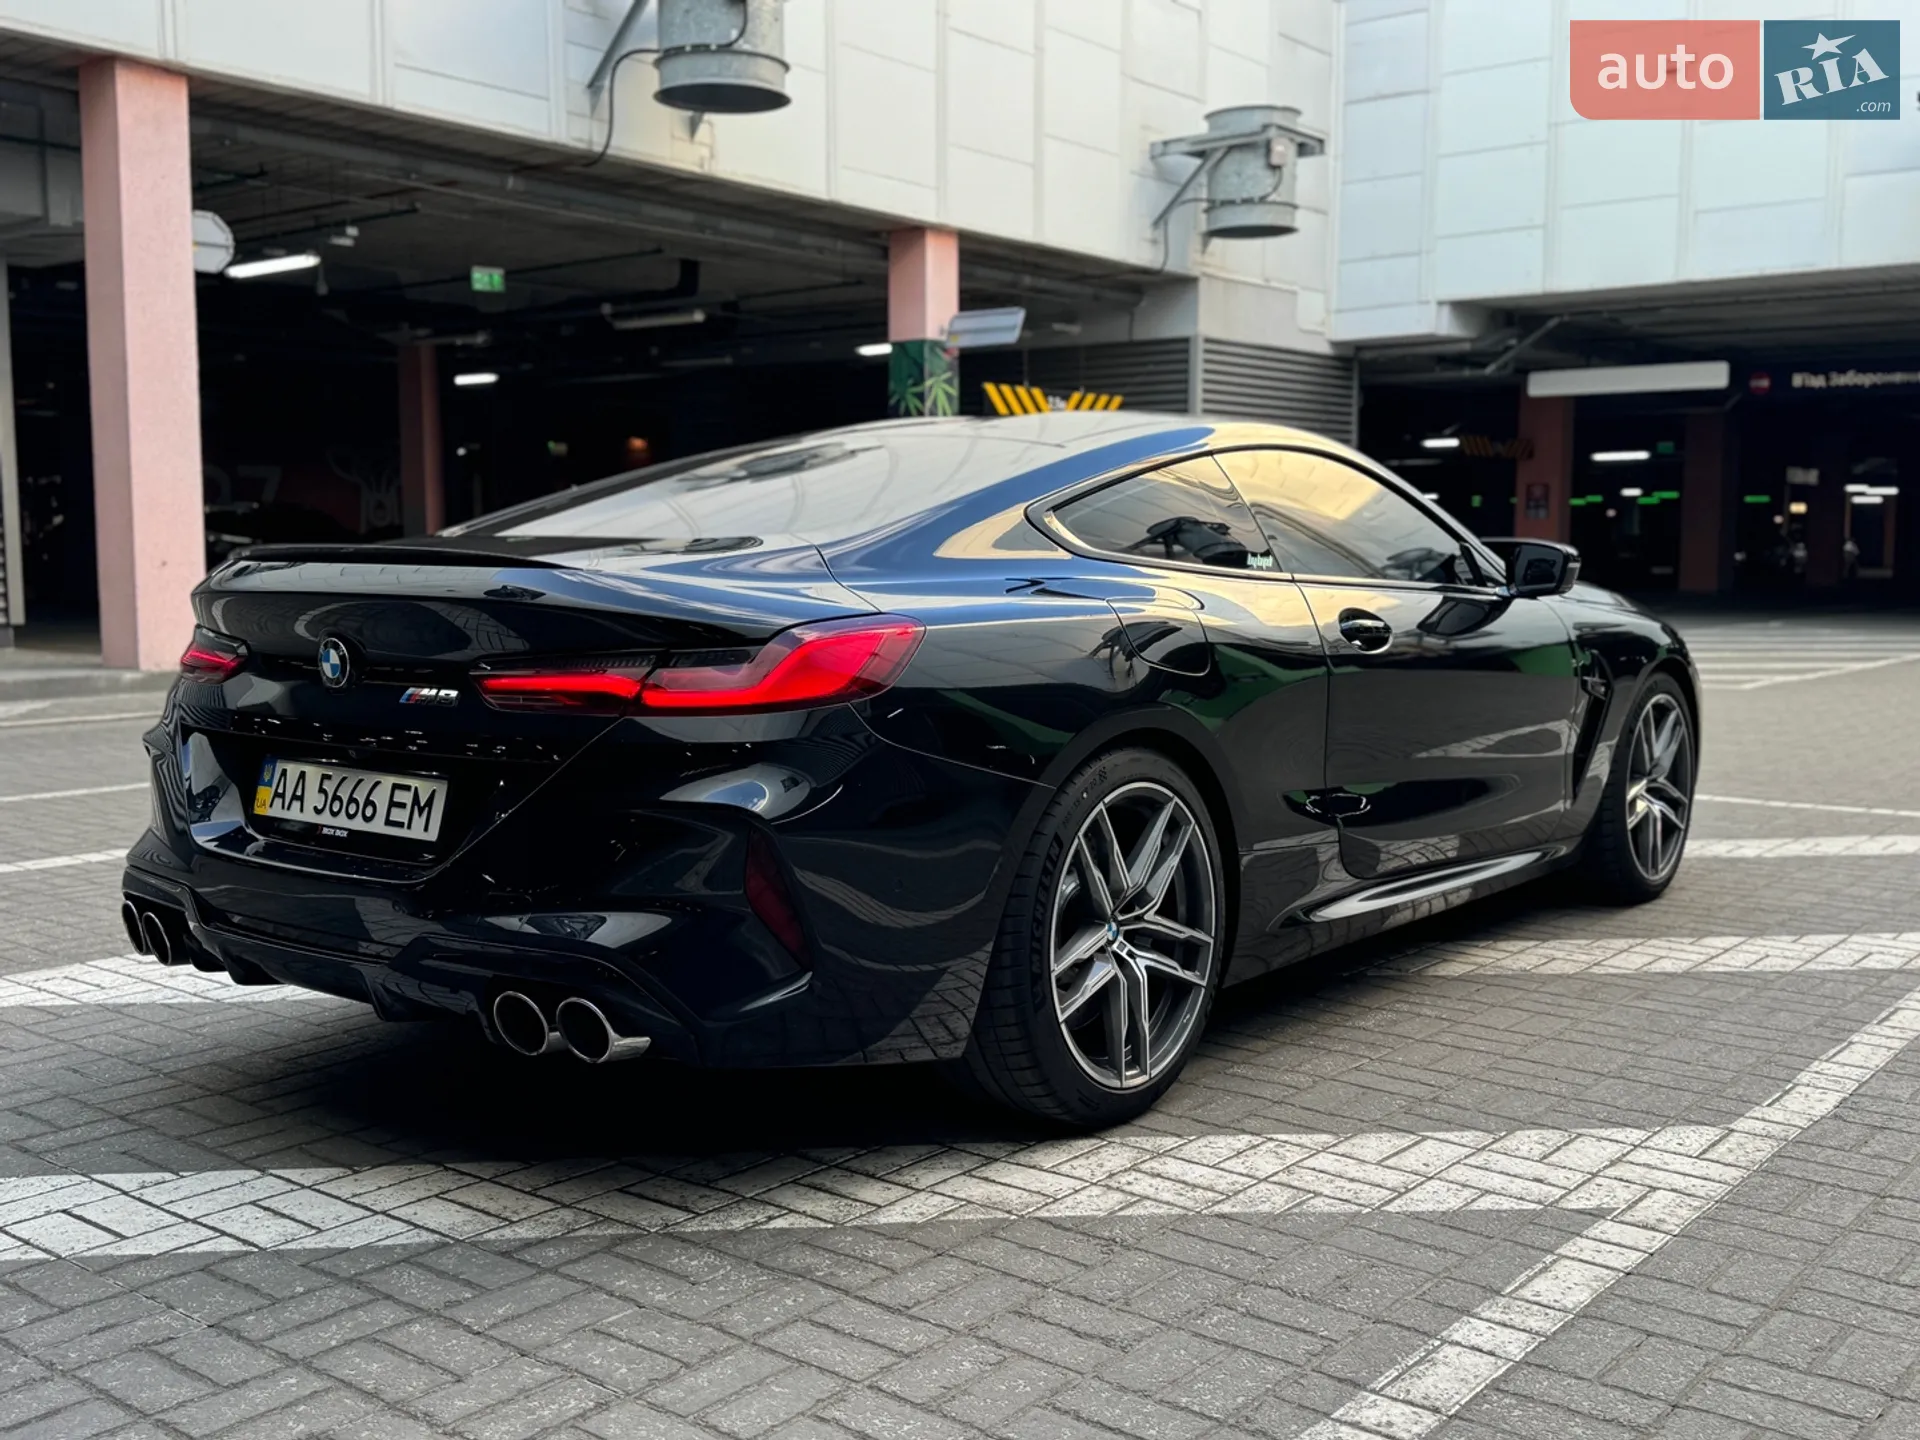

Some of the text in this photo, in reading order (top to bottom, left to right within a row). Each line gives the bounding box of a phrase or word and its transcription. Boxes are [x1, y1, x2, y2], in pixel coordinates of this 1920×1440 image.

[255, 795, 268, 809] UA
[269, 767, 438, 833] AA 5666 EM
[1030, 837, 1061, 974] MICHELIN
